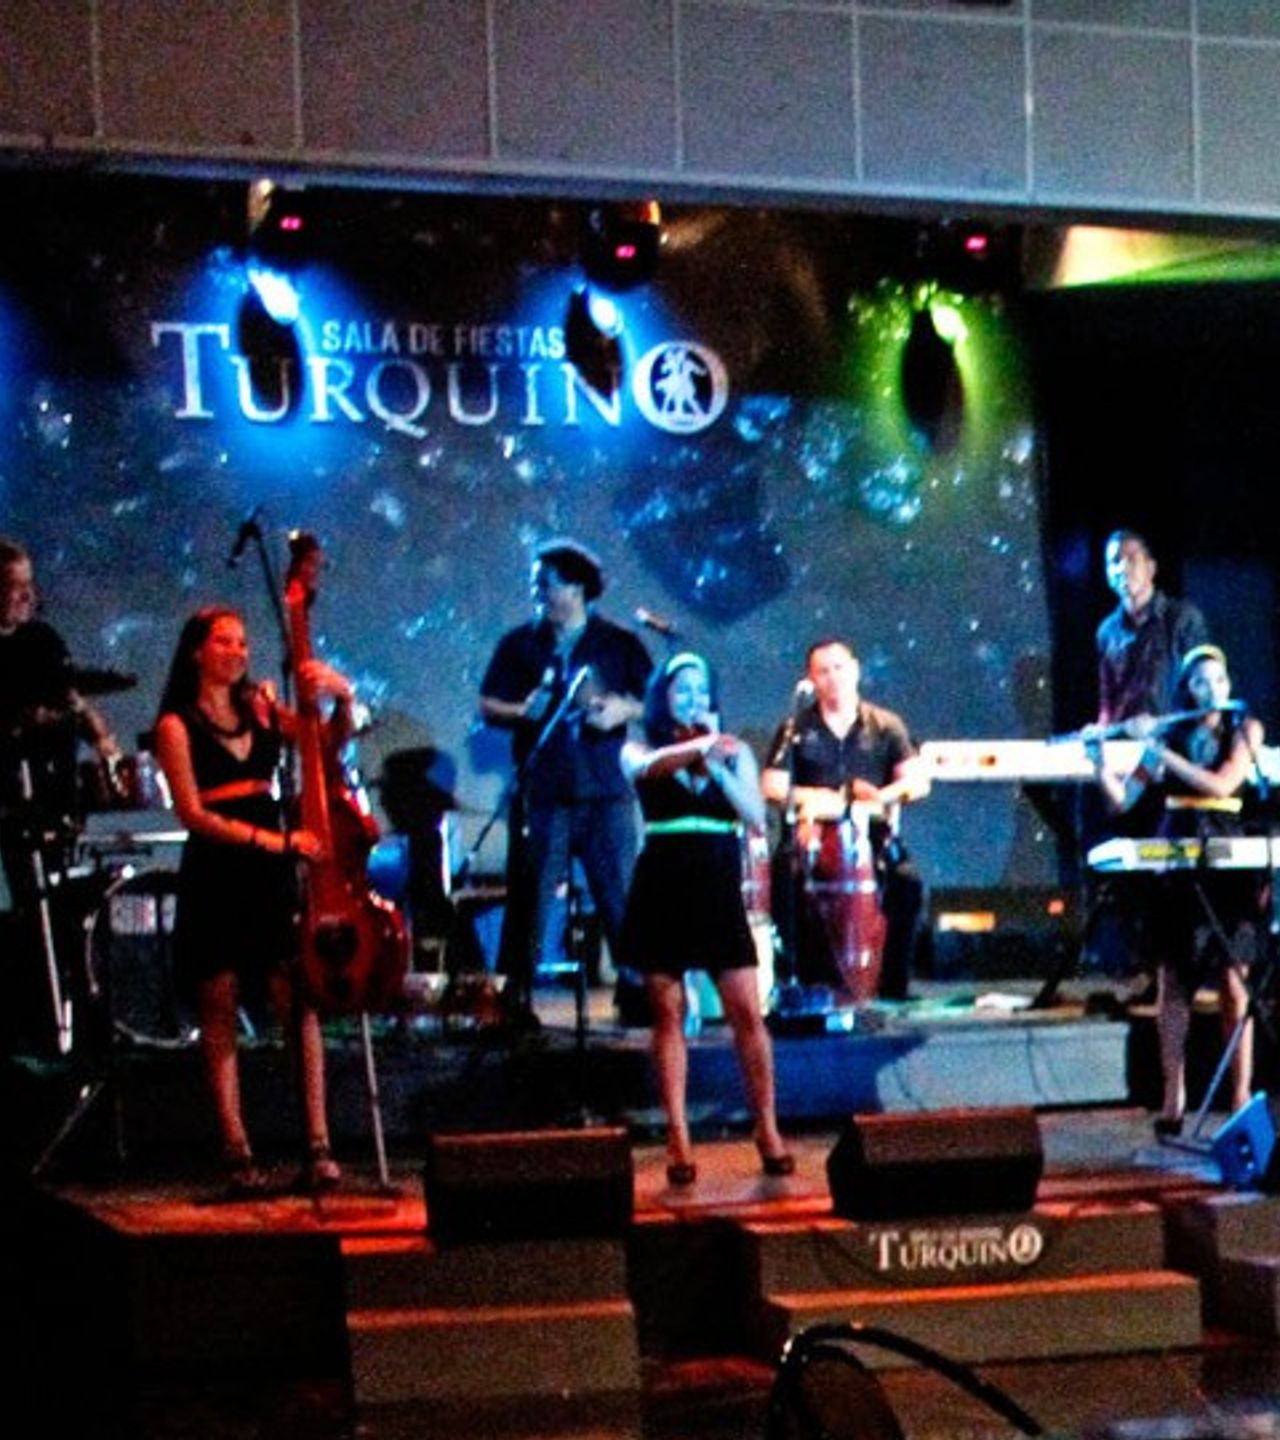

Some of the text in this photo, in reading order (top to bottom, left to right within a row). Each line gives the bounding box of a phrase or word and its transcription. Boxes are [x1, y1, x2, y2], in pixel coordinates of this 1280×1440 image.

[321, 320, 566, 359] SALA DE FIESTAS
[150, 321, 729, 437] TURQUINO
[868, 1224, 1043, 1271] TURQUINO
